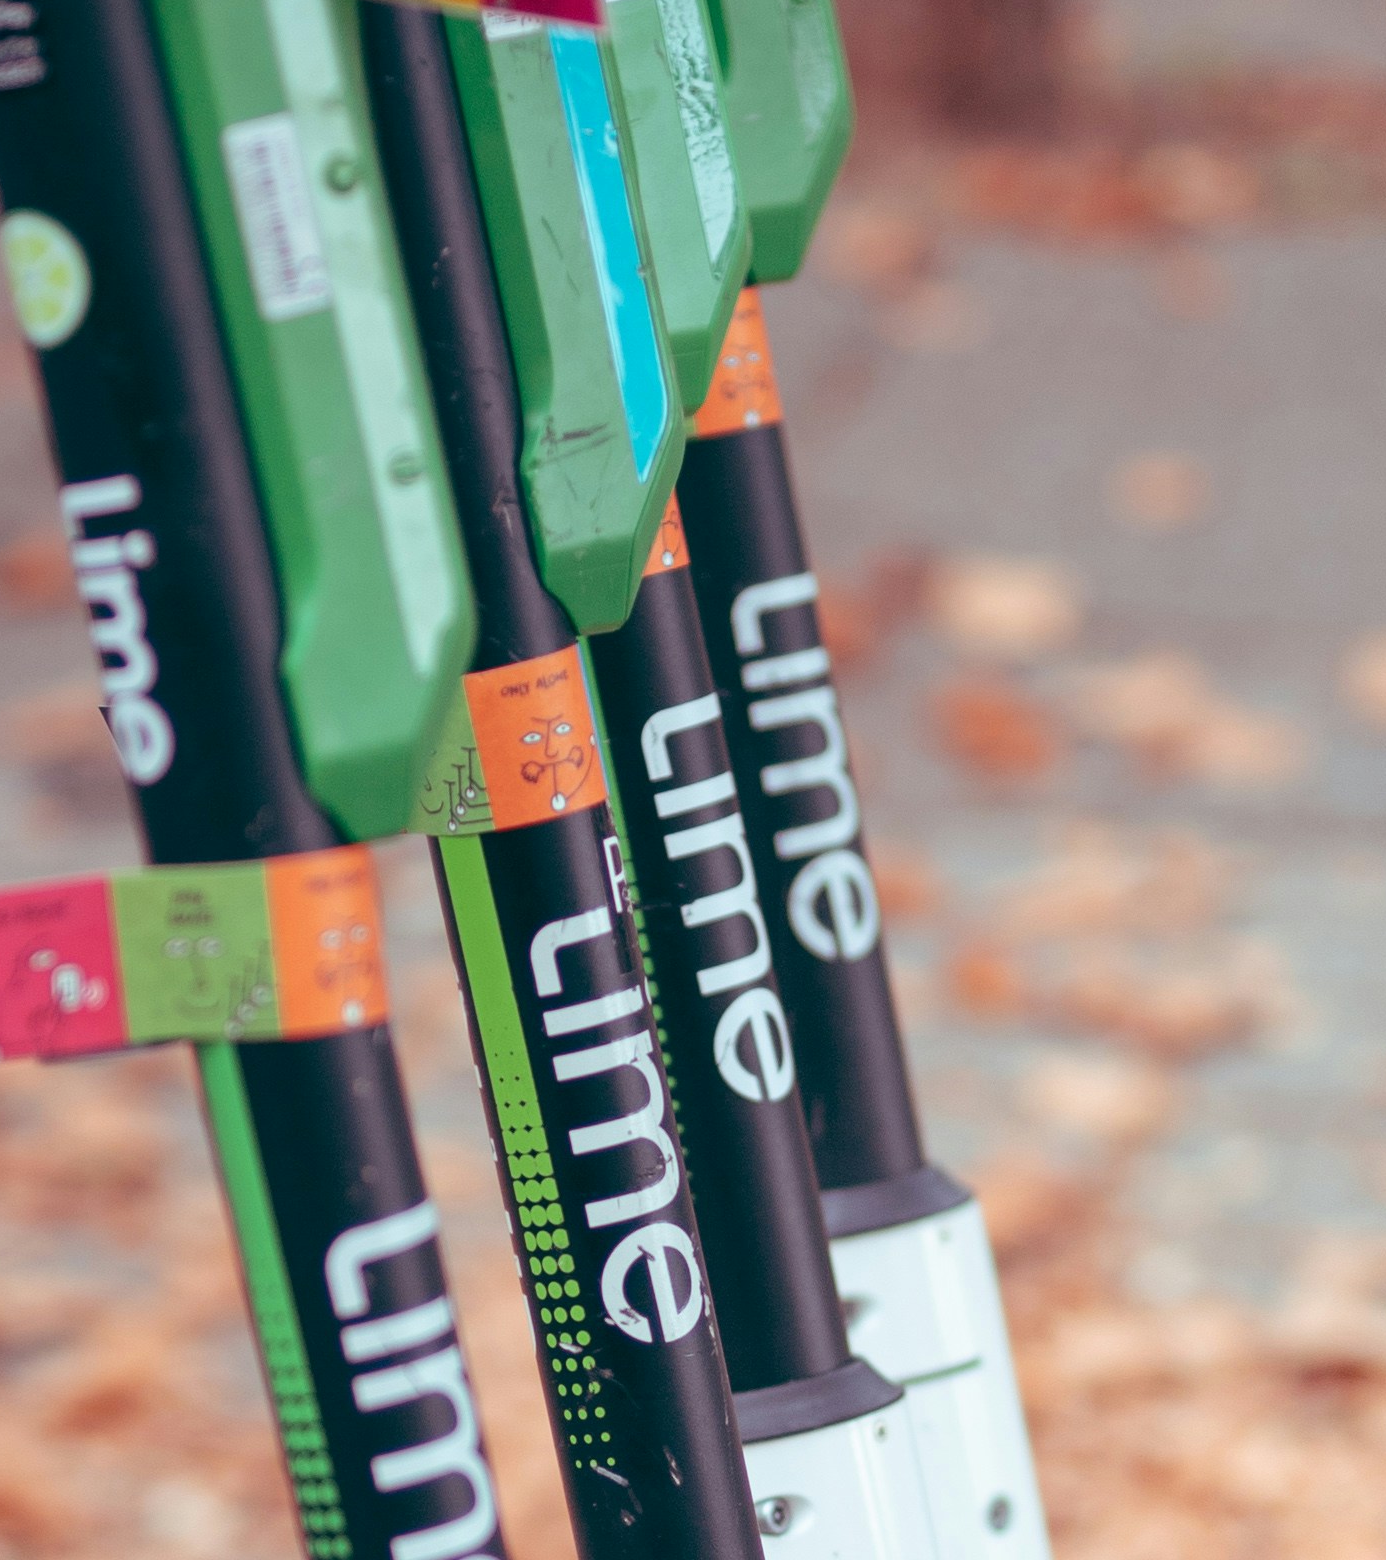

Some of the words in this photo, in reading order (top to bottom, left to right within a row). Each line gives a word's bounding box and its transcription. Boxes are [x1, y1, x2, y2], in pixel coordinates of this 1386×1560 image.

[60, 473, 176, 787] Lime
[731, 571, 880, 962] Lime
[641, 692, 795, 1103] Lime
[530, 906, 704, 1344] Lime
